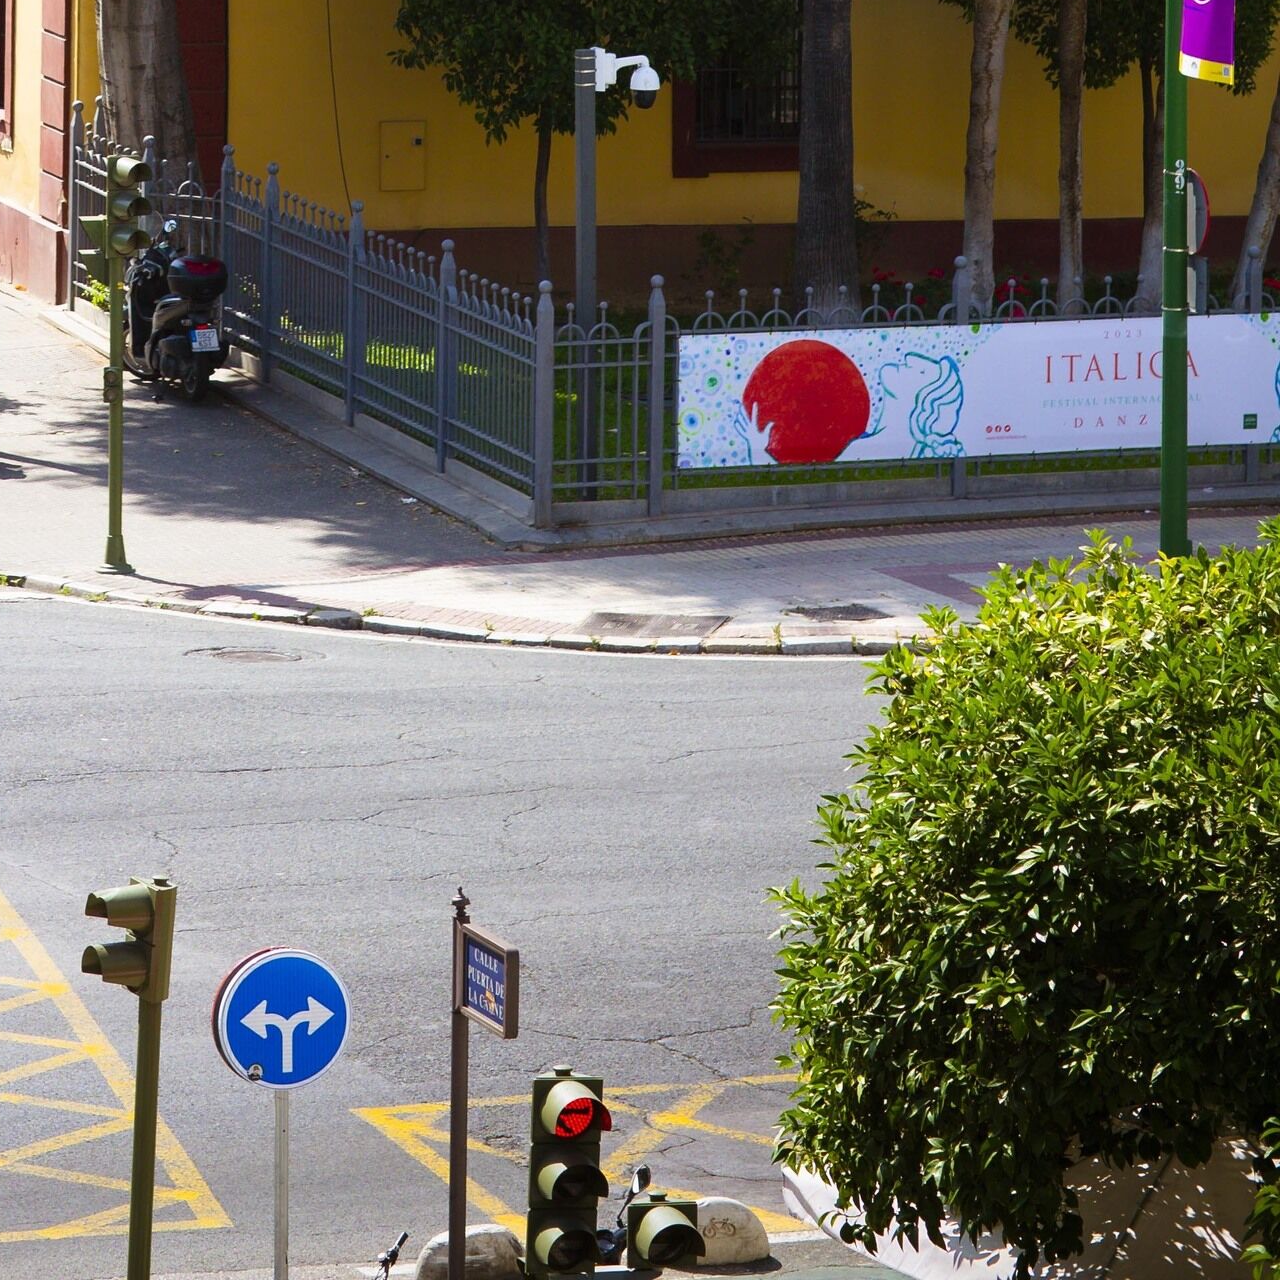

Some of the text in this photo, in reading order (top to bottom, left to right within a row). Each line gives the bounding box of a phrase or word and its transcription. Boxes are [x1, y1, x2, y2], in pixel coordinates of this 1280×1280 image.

[1103, 328, 1143, 340] 2023
[1042, 392, 1202, 409] FESTIVAL INTERNACAL
[1072, 413, 1154, 430] DANZ
[474, 948, 499, 974] CALLE
[467, 964, 505, 1000] PUERTA DE
[468, 986, 478, 1005] LA
